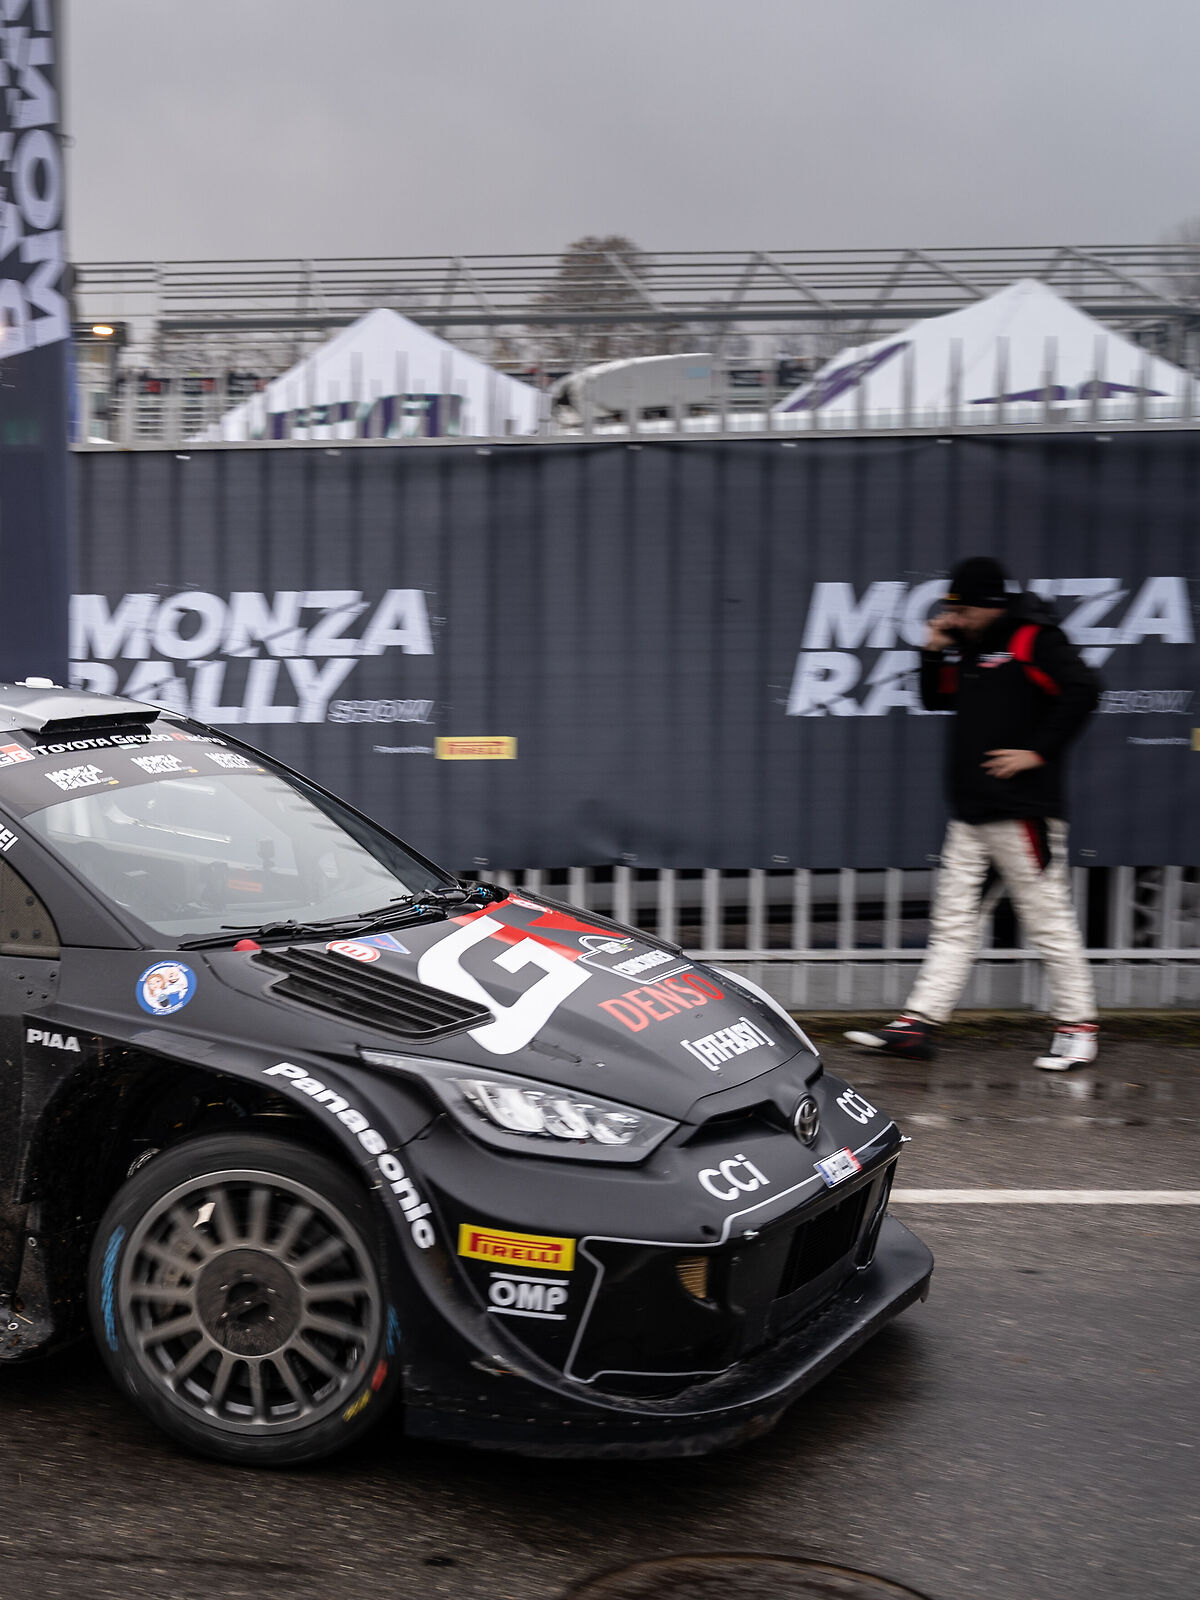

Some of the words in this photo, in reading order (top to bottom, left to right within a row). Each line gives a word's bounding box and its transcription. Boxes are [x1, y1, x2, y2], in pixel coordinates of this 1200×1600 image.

[69, 588, 435, 659] MONZA
[801, 576, 1196, 650] MZA
[30, 737, 113, 756] TOYOTA
[110, 734, 174, 745] GAZOO
[44, 764, 103, 782] MONZA
[598, 973, 725, 1033] DENSO
[26, 1028, 82, 1053] PIAA
[262, 1062, 436, 1249] Panasonic
[469, 1231, 566, 1265] PIRELLI
[489, 1280, 569, 1312] OMP
